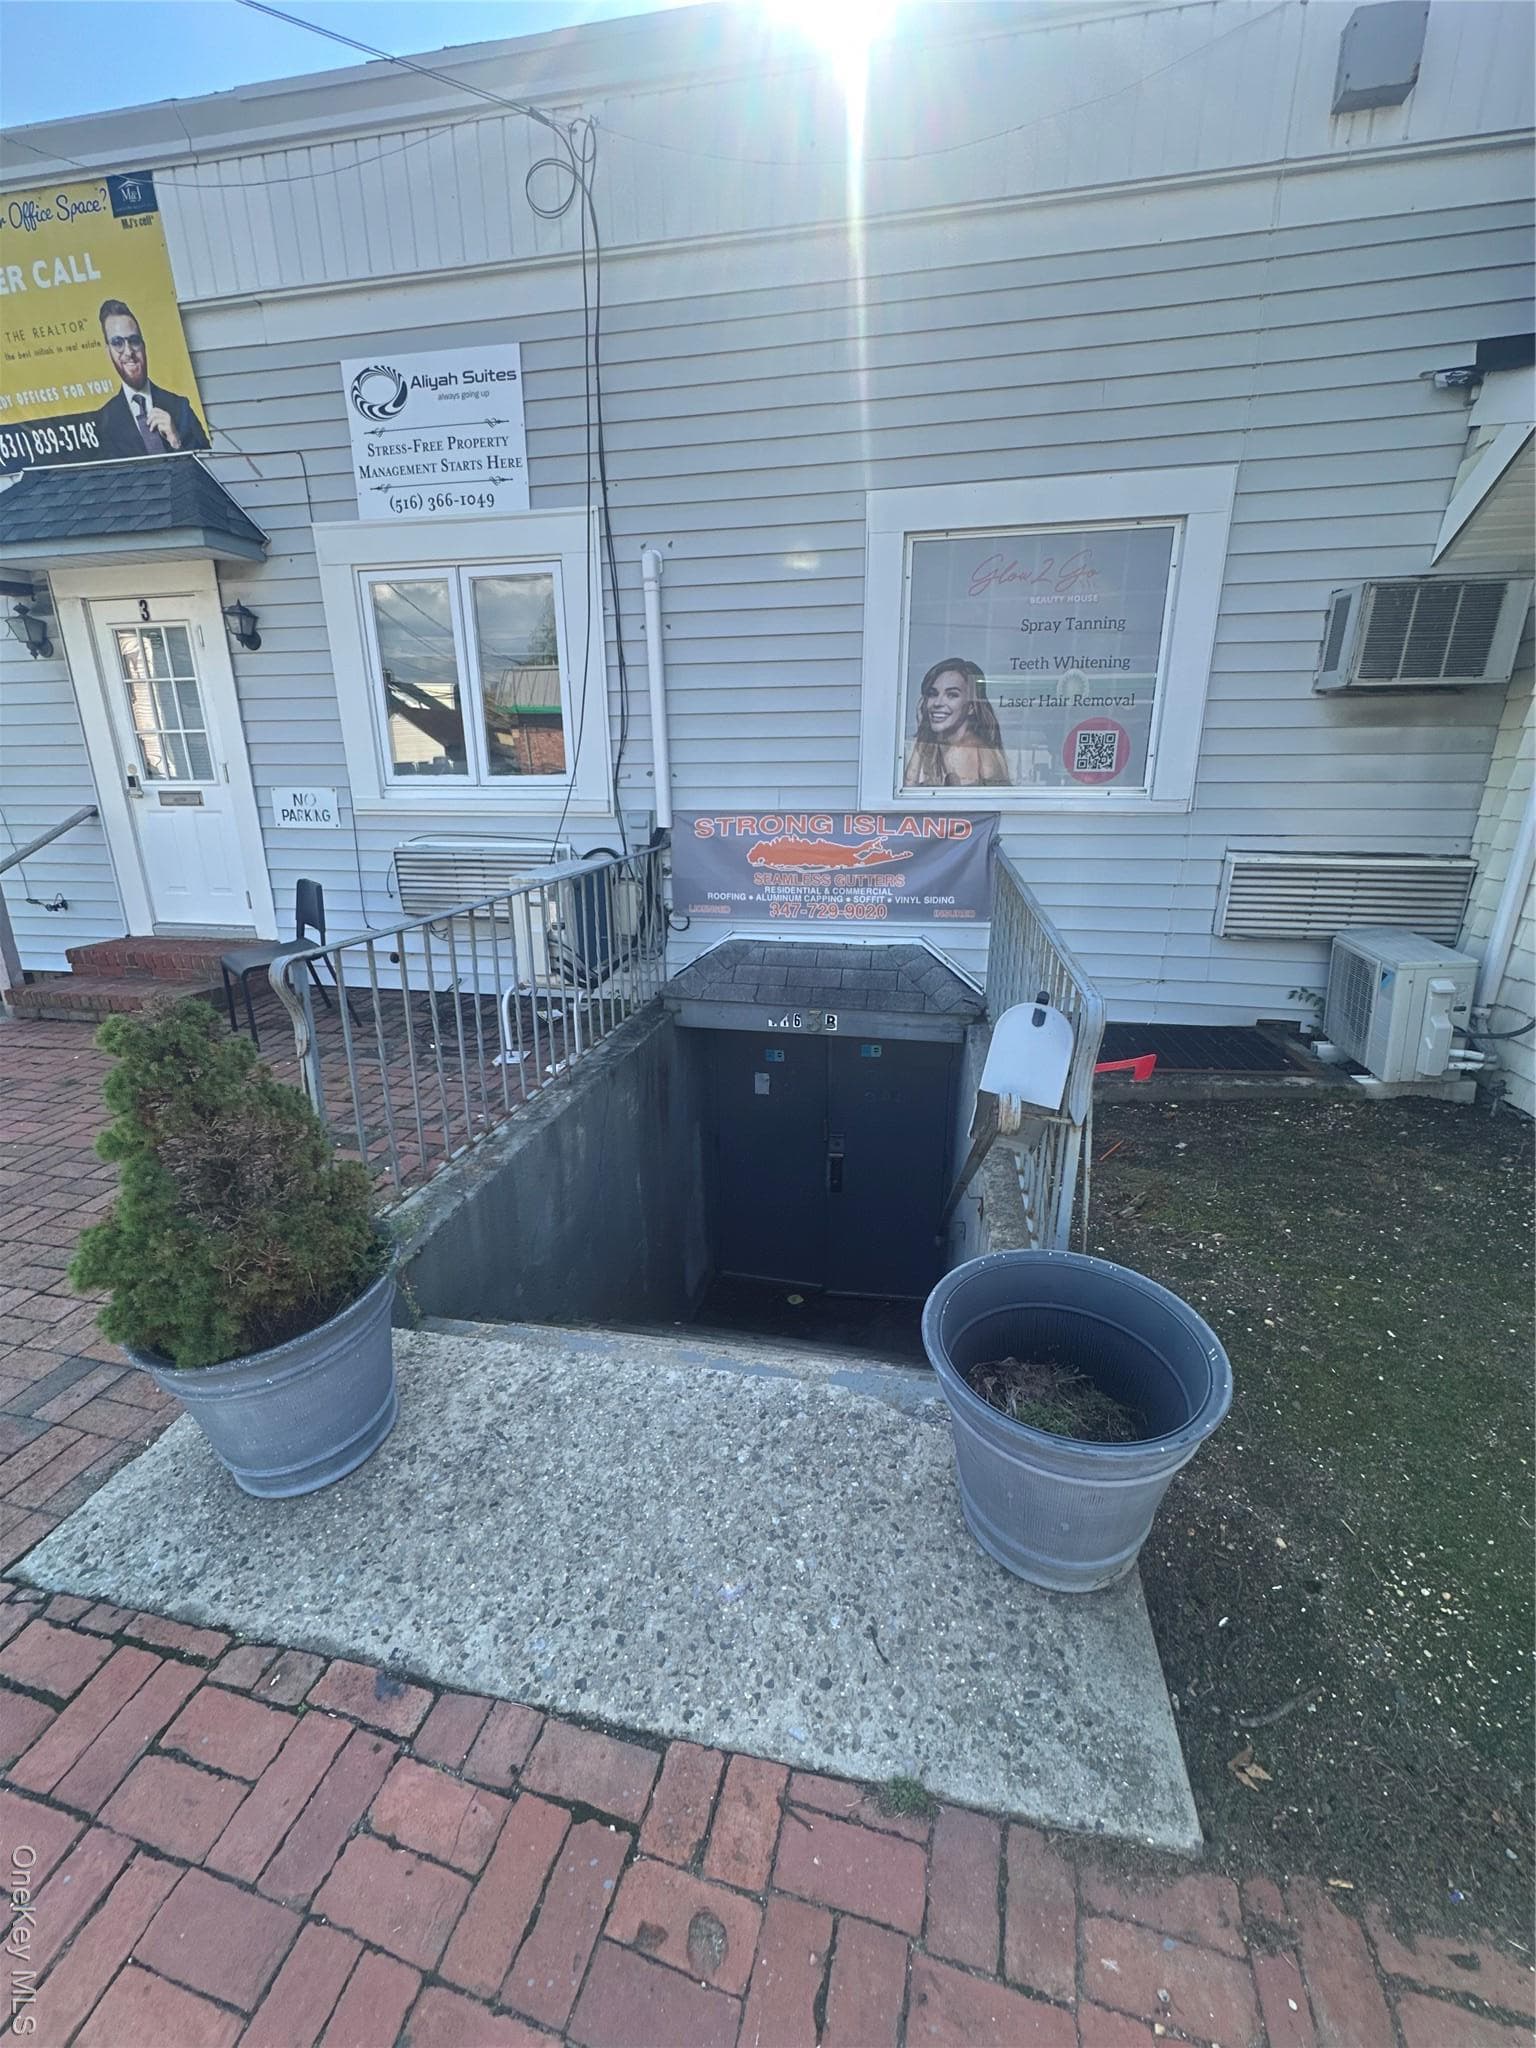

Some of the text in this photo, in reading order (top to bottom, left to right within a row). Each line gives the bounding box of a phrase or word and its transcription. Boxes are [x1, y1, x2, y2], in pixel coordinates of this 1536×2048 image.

[9, 188, 107, 232] Office Space?
[32, 252, 102, 289] CALL
[5, 330, 25, 344] THE
[410, 369, 517, 391] Aliyah Suites
[16, 387, 60, 407] OFFICES
[62, 383, 85, 398] FOR
[86, 379, 114, 395] YOU!
[438, 390, 490, 401] always going up
[31, 422, 99, 455] 839-3748
[389, 493, 495, 514] (516) 366-1049
[968, 553, 1032, 596] Glow
[1031, 558, 1053, 584] 2
[1029, 594, 1099, 605] BEAUTY HOUSE
[139, 600, 150, 621] 3
[1020, 616, 1127, 634] Spray Tanning
[1010, 655, 1131, 671] Teeth Whitening
[999, 693, 1136, 708] Laser Hair Removal
[694, 814, 973, 840] STRONG ISLAND
[753, 872, 905, 887] SEAMLESS GUTTERS
[707, 892, 955, 905] ROOFING ALUMINUM CAPPING SOFFIT VINYL SIDING
[764, 886, 893, 896] RESIDENTIAL & COMMERCIAL
[769, 903, 888, 919] 347-729-9020
